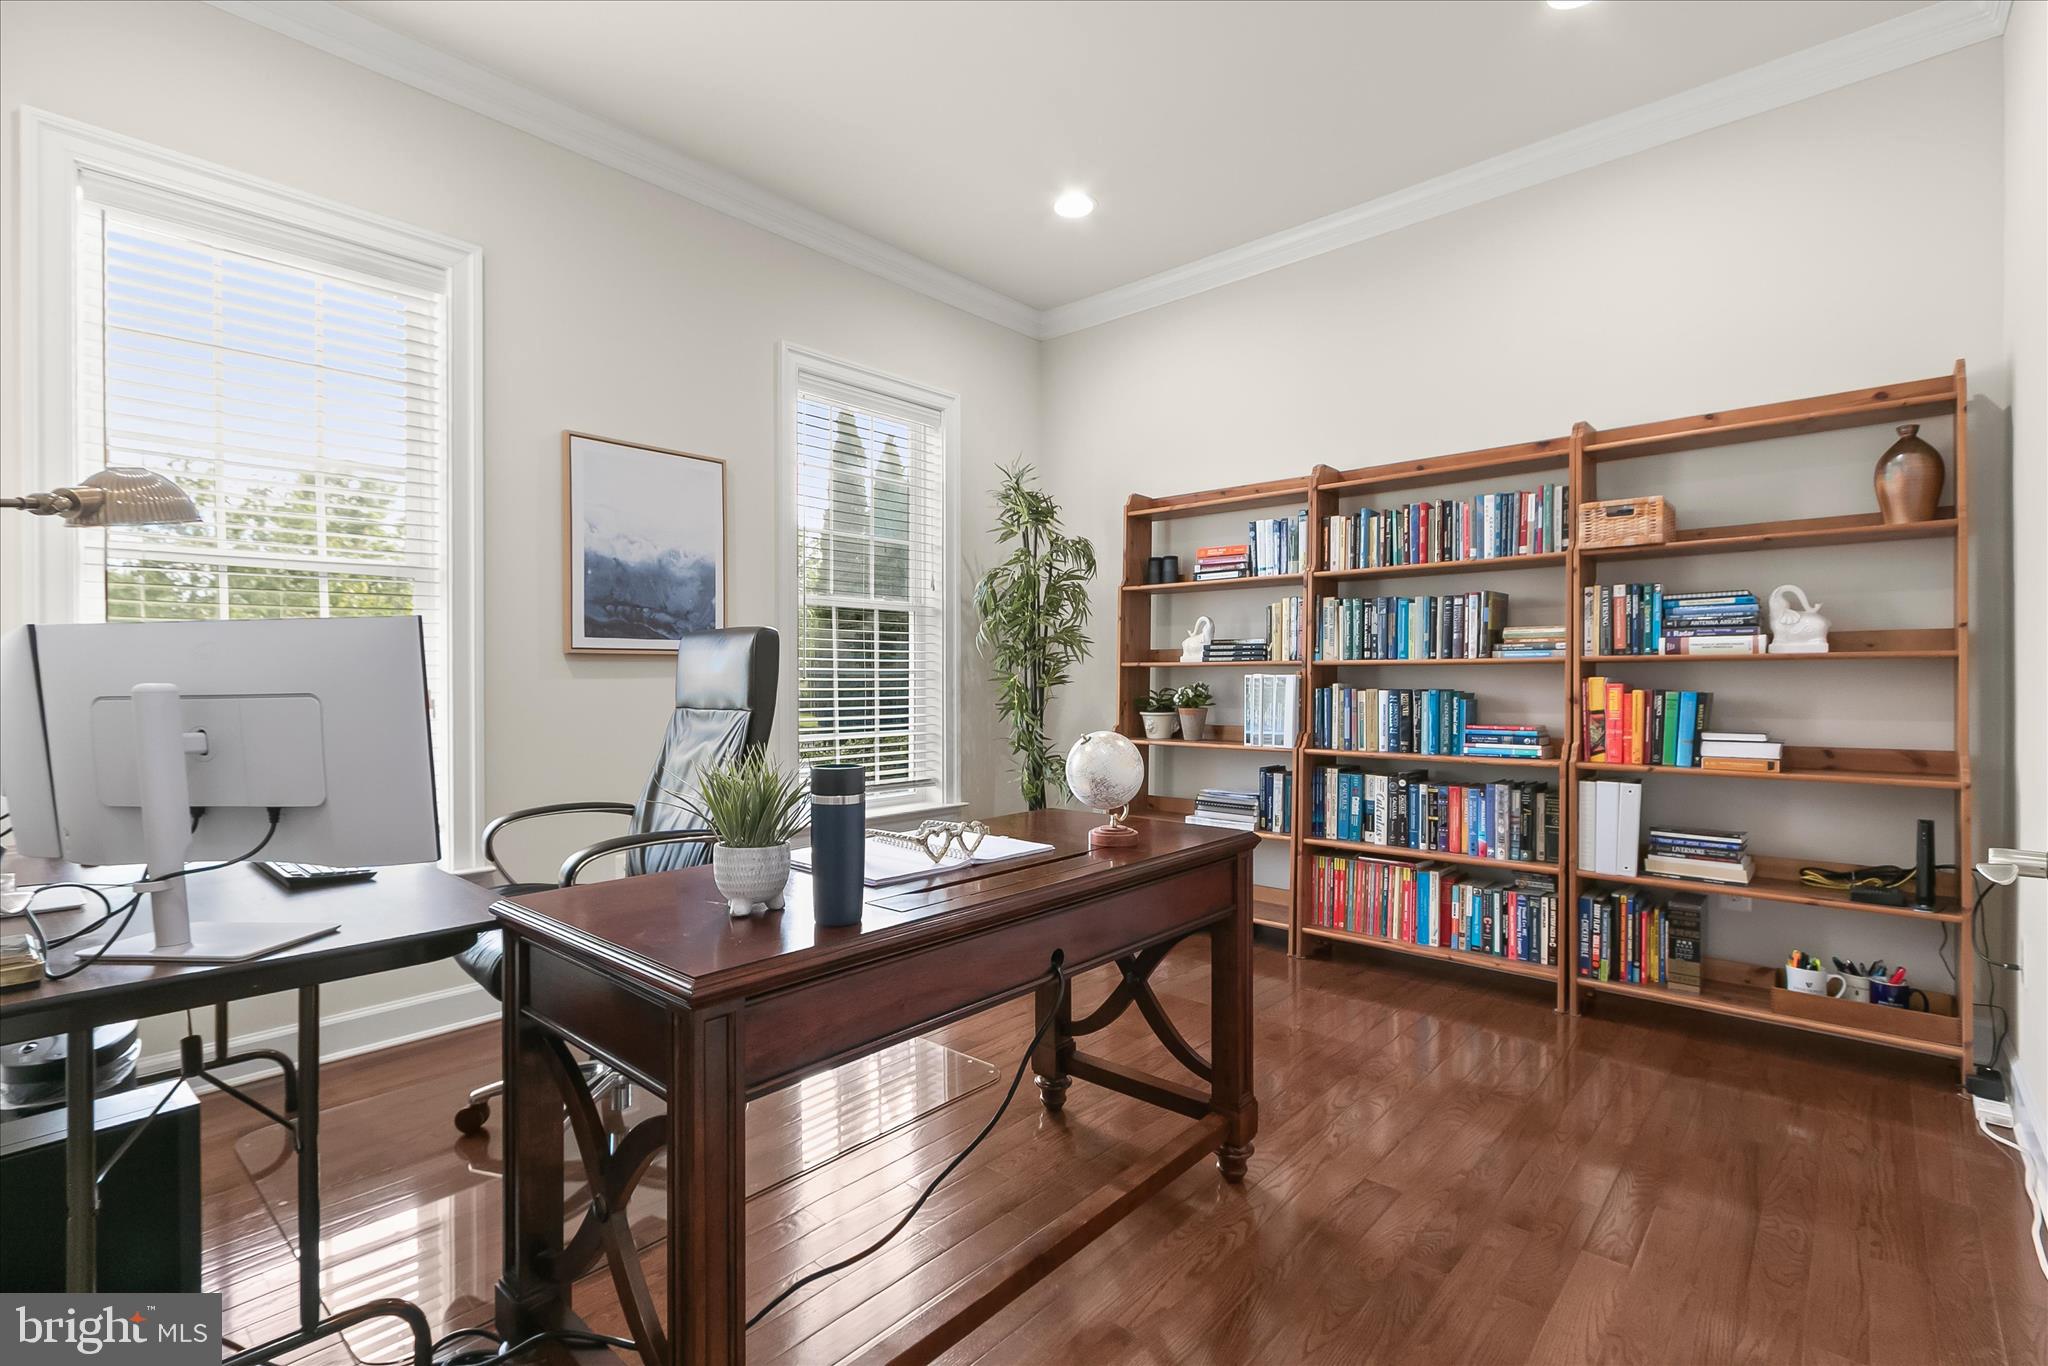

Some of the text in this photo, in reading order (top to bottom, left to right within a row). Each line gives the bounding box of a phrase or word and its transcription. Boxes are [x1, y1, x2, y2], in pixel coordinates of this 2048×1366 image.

[1376, 793, 1386, 837] Calculus
[1671, 846, 1705, 855] LIVERMORE
[1580, 918, 1589, 942] CHICKEN
[1580, 942, 1589, 958] BIBLE
